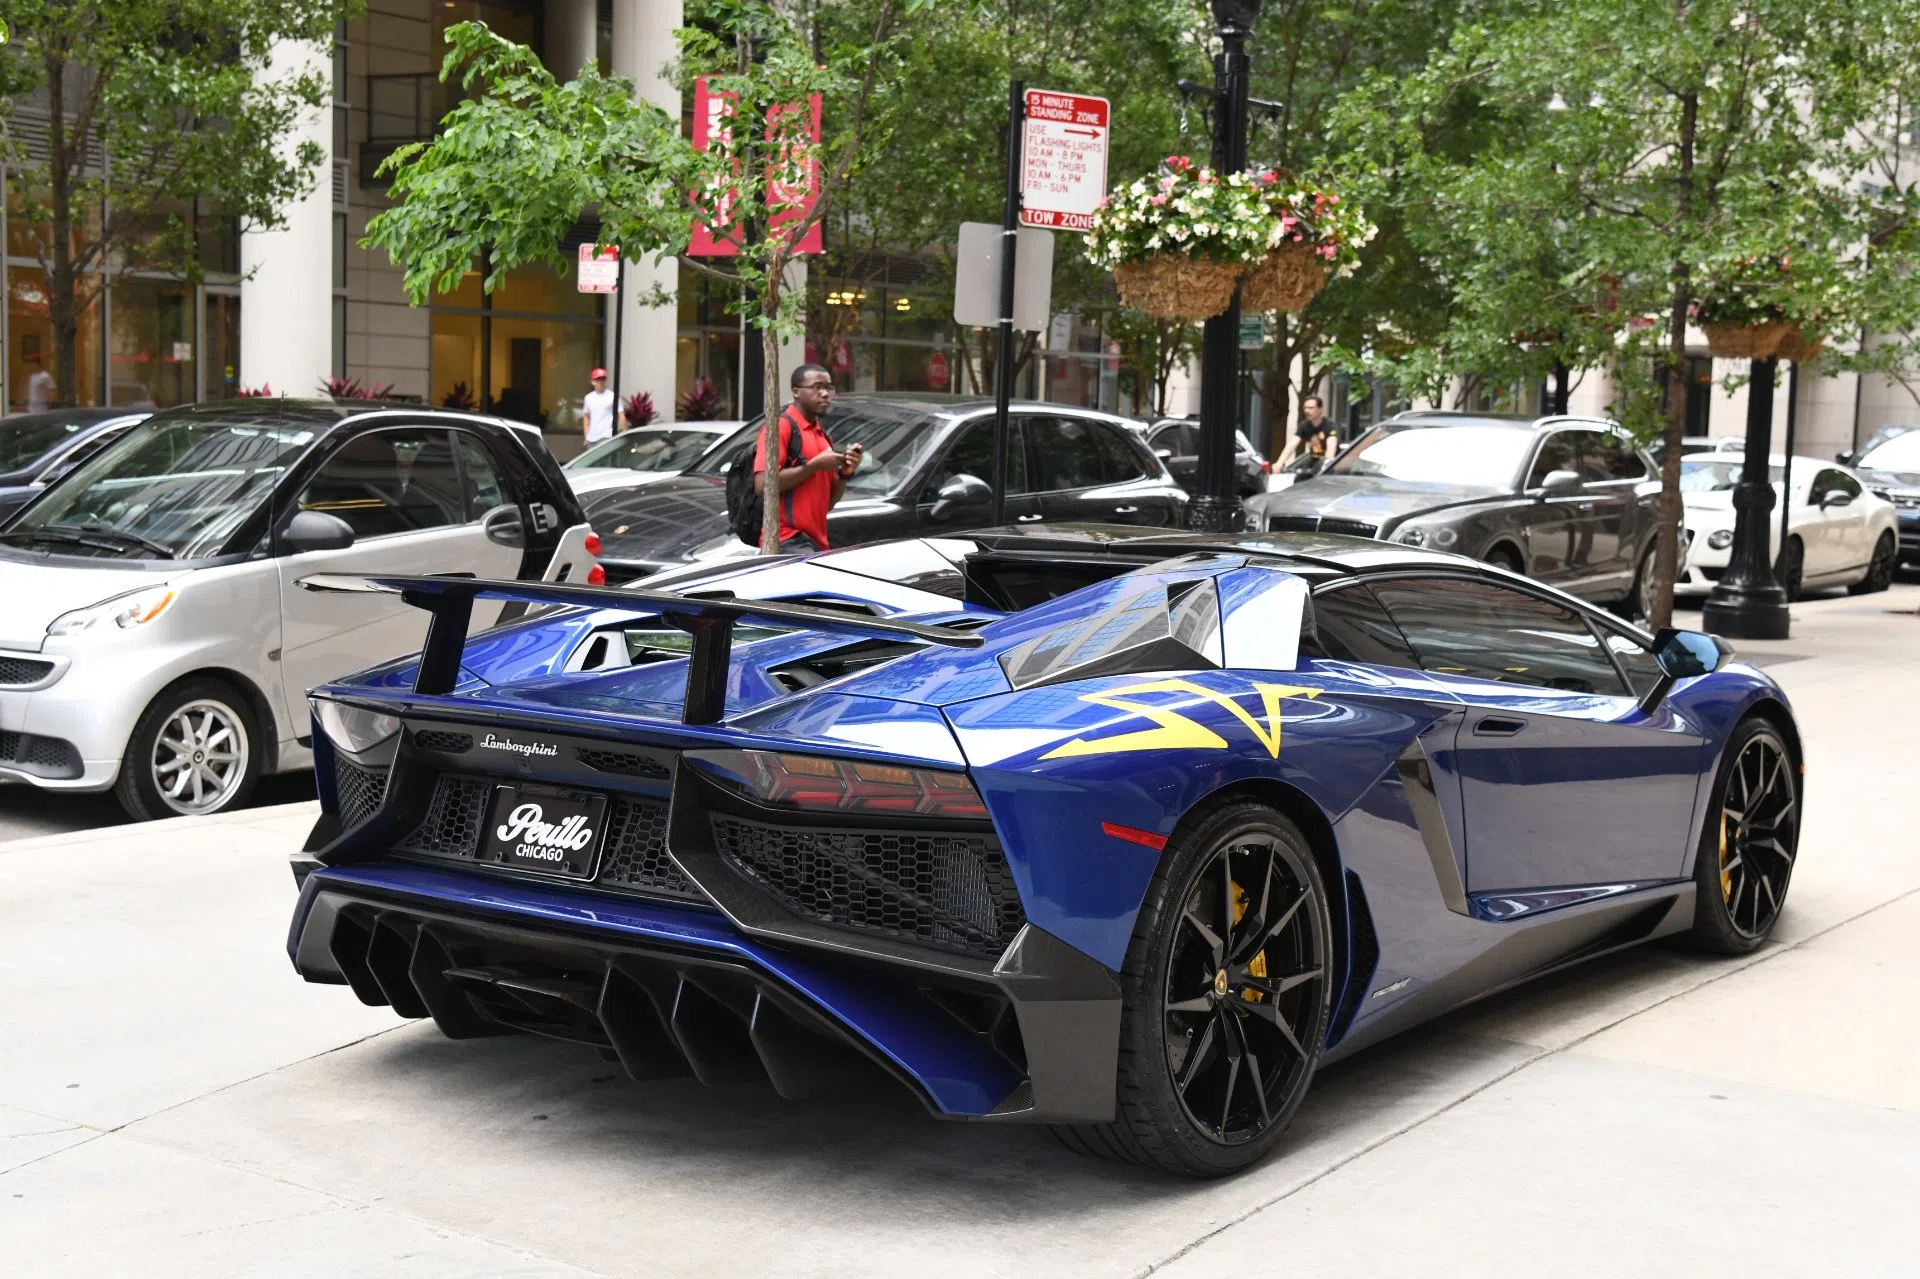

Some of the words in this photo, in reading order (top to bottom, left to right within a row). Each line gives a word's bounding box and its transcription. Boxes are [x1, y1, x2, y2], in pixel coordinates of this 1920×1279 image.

[1030, 94, 1040, 106] 15
[1042, 95, 1075, 109] MINUTE
[1030, 106, 1073, 121] STANDING
[1076, 111, 1099, 124] ZONE
[1029, 124, 1046, 135] USE
[1029, 135, 1071, 149] FLASHING
[1073, 140, 1102, 153] LIGHTS
[1029, 147, 1038, 156] 10
[1040, 148, 1053, 157] AM
[1063, 151, 1068, 160] 8
[1071, 151, 1083, 161] PM
[1029, 158, 1047, 169] MON
[1058, 161, 1087, 173] THURS
[1028, 169, 1037, 179] 10
[1039, 170, 1051, 179] AM
[1061, 173, 1066, 182] 6
[1069, 173, 1082, 183] PM
[1027, 180, 1042, 190] FRI
[1050, 182, 1069, 193] SUN
[1025, 209, 1055, 225] TOW
[480, 733, 559, 757] Lamborghini
[496, 803, 593, 851] Perillo
[515, 843, 564, 862] CHICAGO
